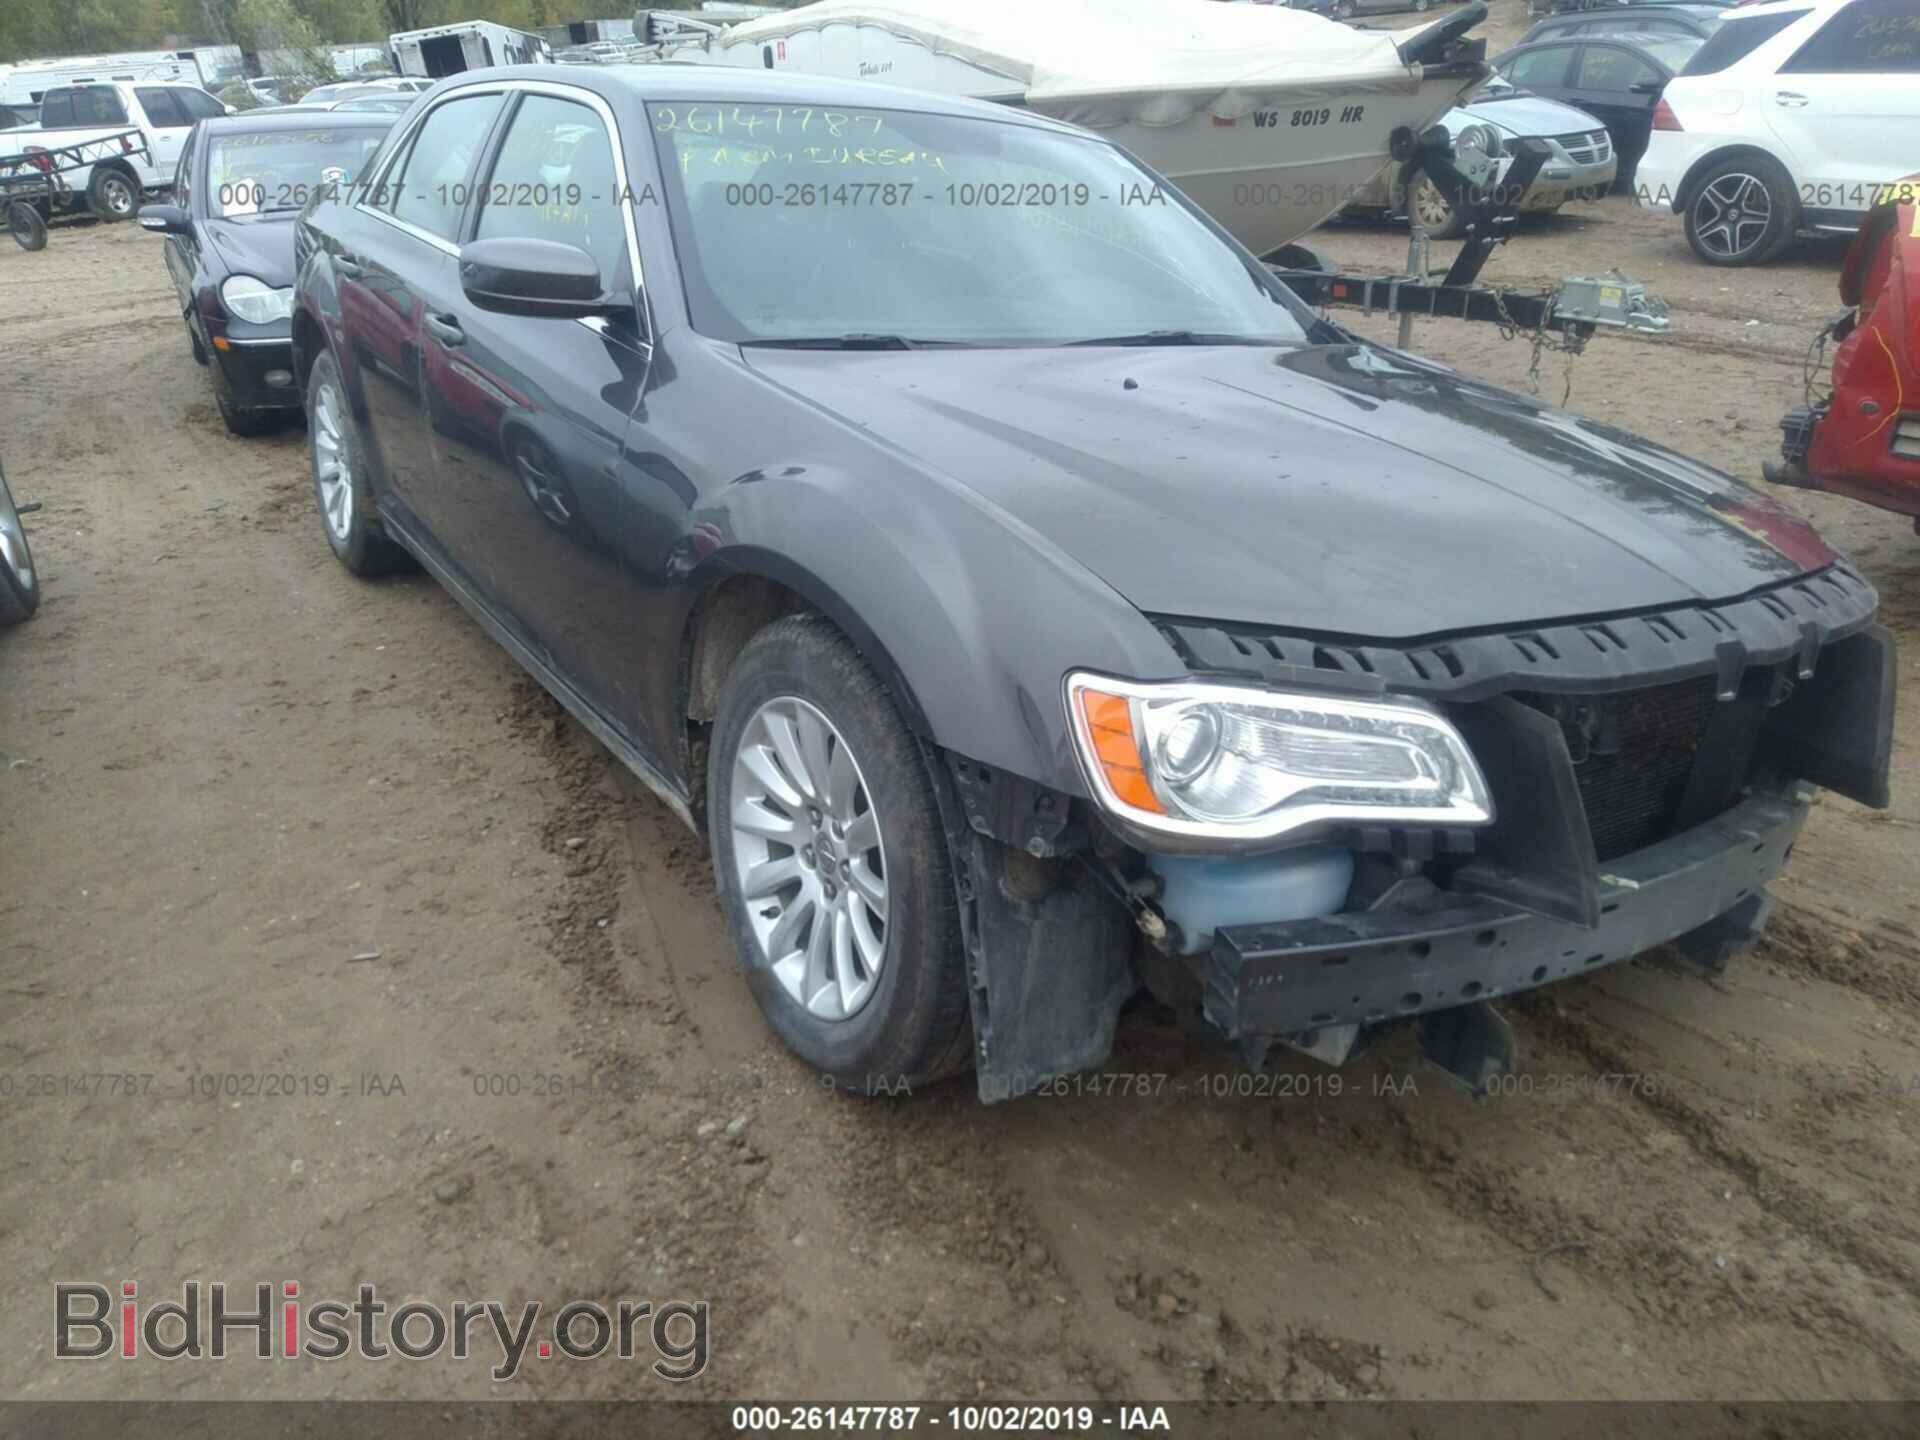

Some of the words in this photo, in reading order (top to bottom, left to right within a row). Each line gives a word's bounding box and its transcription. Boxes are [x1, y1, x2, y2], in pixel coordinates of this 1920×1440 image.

[656, 107, 882, 137] 26147787
[1290, 108, 1330, 127] 8019
[1341, 105, 1364, 123] HR
